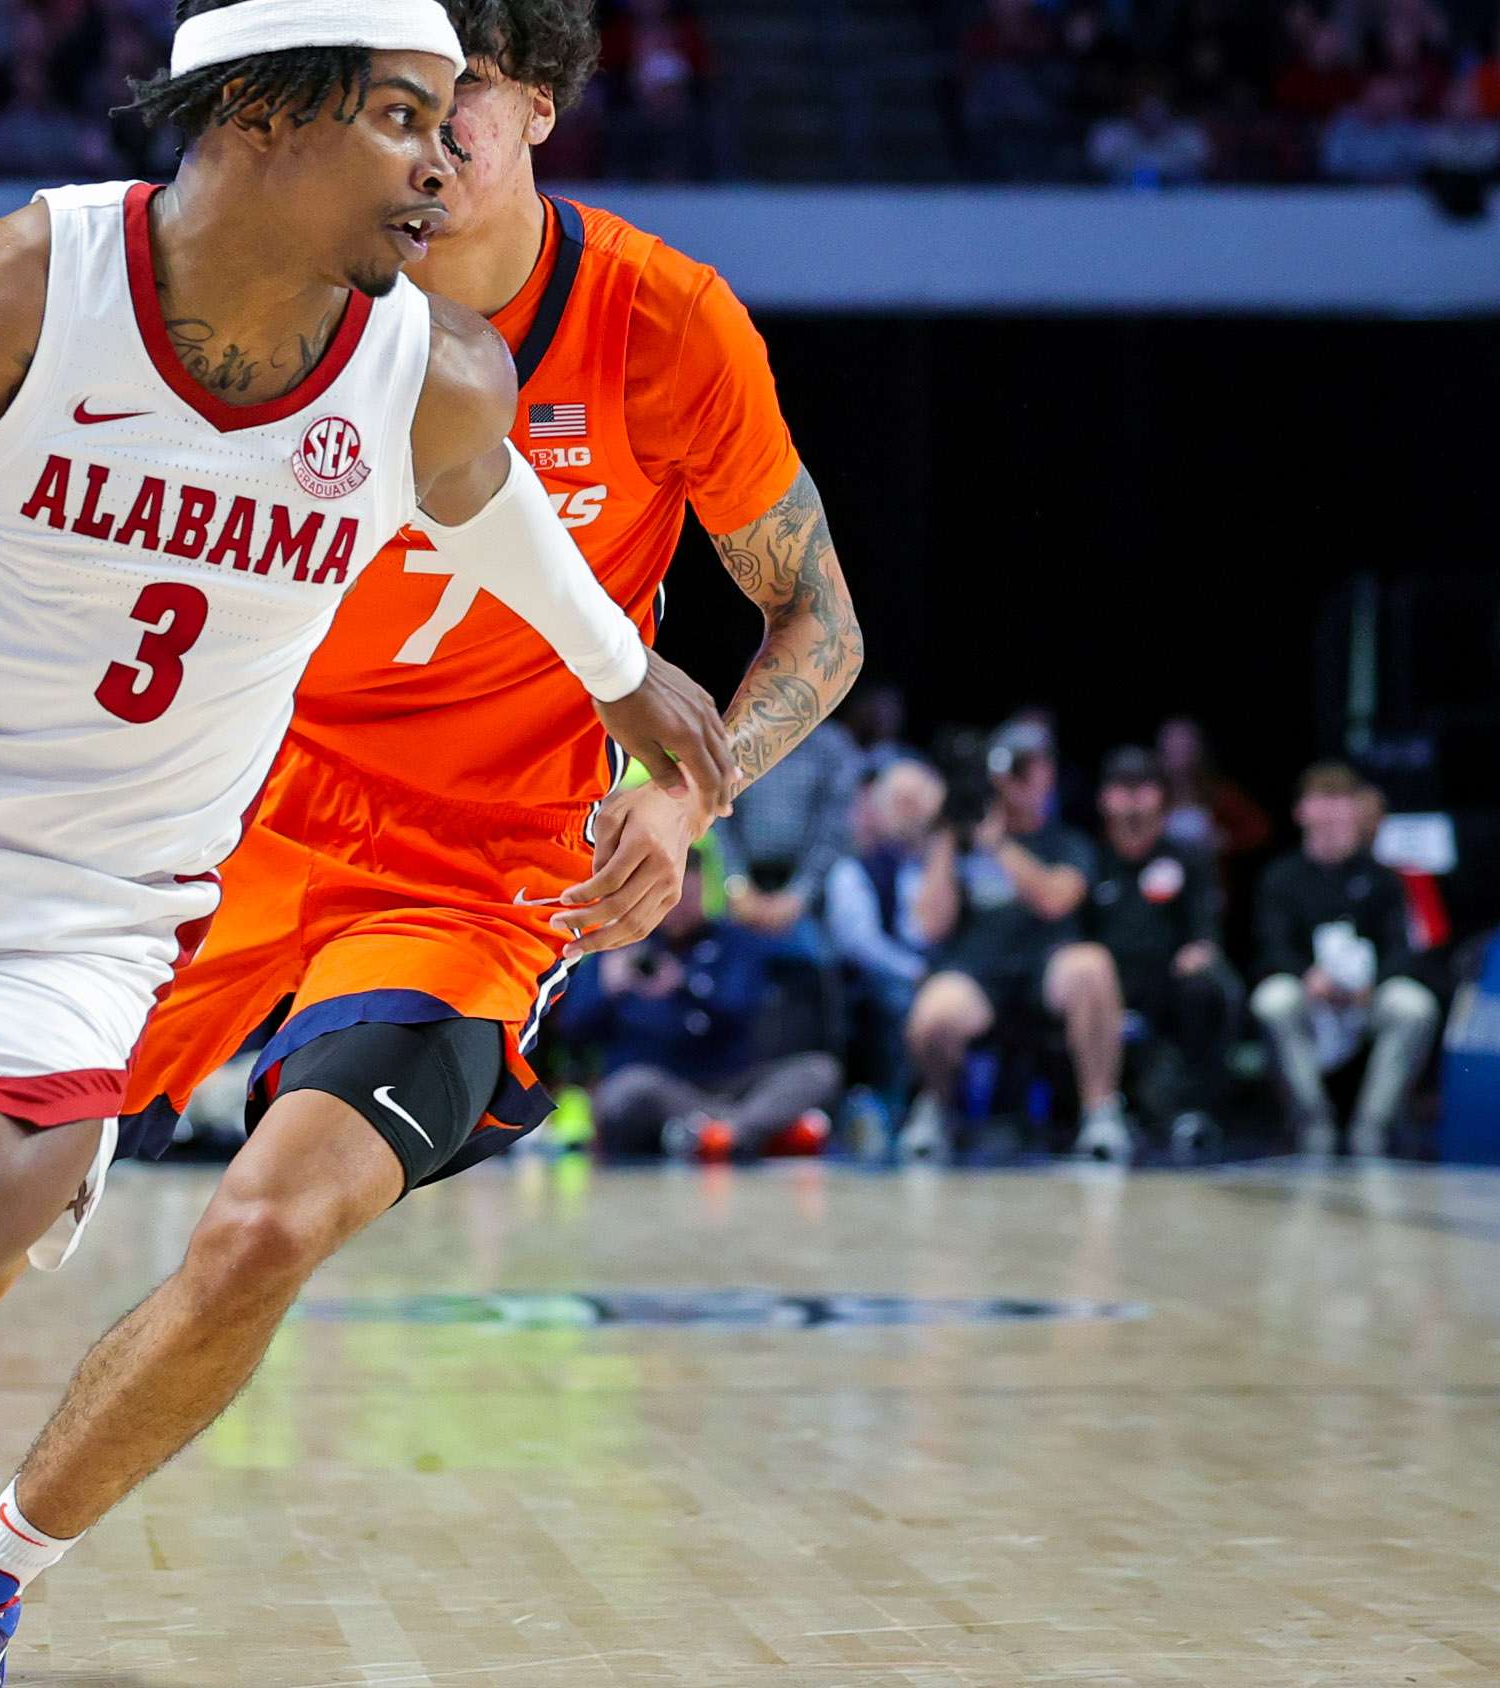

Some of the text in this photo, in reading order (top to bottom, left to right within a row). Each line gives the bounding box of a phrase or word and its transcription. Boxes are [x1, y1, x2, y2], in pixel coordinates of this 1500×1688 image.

[296, 467, 358, 497] GRADUATE
[304, 418, 359, 478] SEC
[20, 453, 359, 584] ALABAMA
[94, 581, 209, 724] 3
[391, 549, 484, 665] 7
